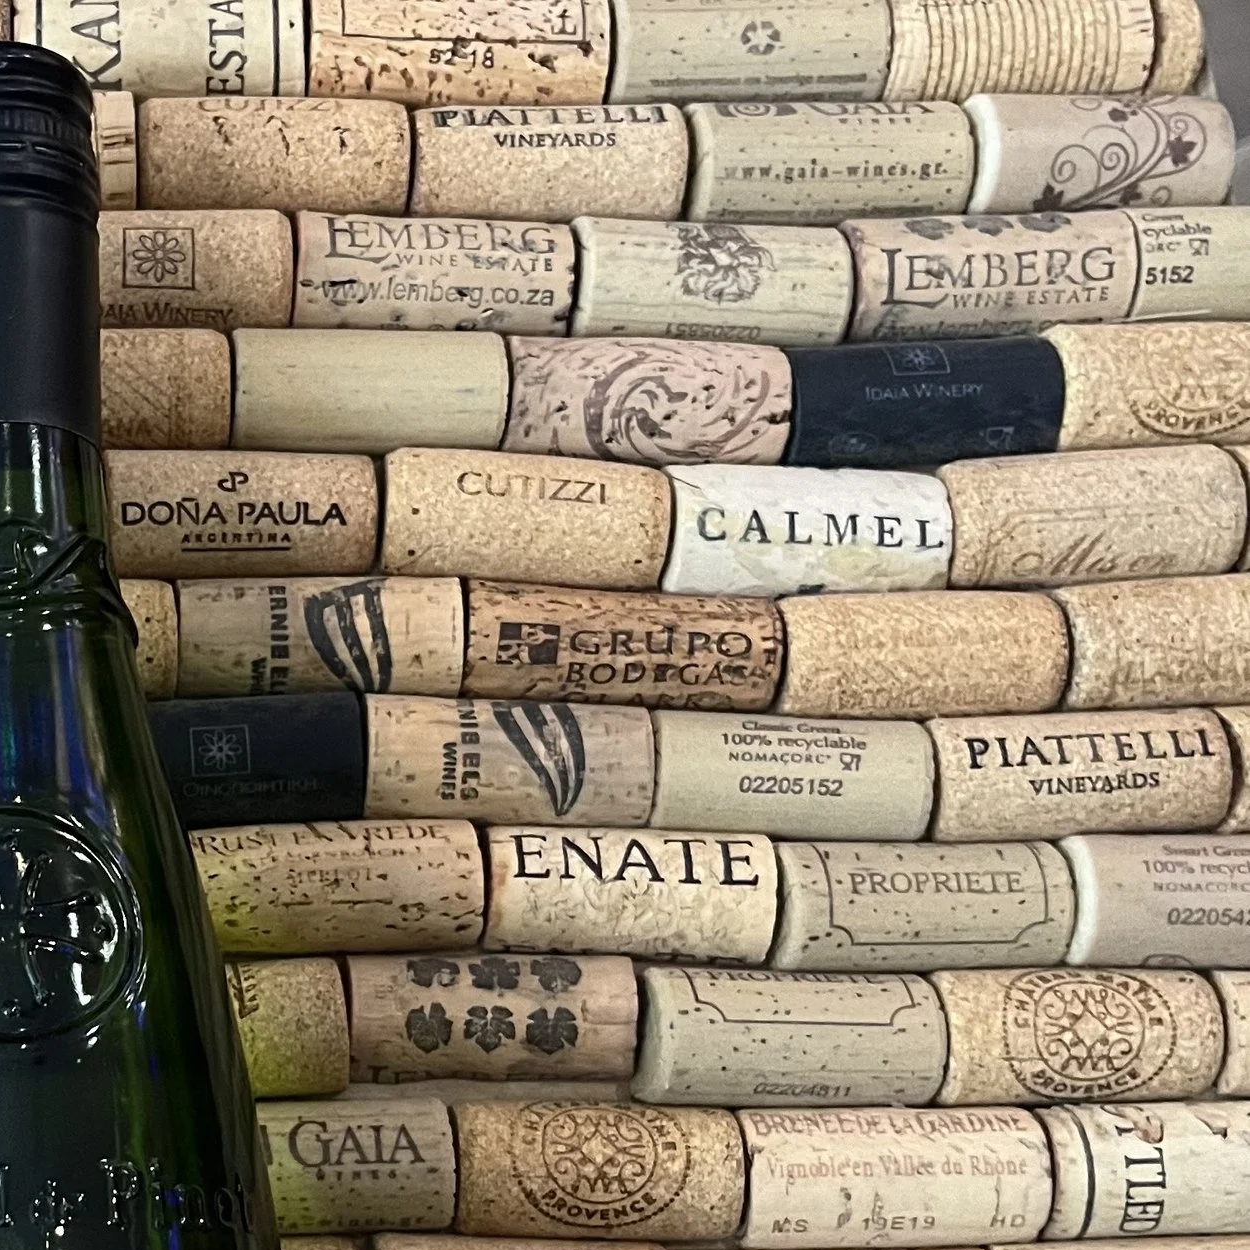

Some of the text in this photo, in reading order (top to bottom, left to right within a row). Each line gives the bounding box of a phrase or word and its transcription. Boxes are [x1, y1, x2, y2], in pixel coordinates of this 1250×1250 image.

[206, 0, 245, 97] ESTA
[433, 104, 668, 128] PIATTELLI
[495, 131, 617, 149] VINEYARDS
[324, 215, 556, 263] LEMBERG
[396, 252, 459, 267] WINE
[881, 246, 1116, 309] LEMBERG
[1145, 265, 1195, 285] 5152
[952, 286, 1110, 309] WINE ESTATE
[456, 470, 608, 504] CUTIZZI
[121, 497, 348, 527] DOÑA PAULA
[181, 531, 293, 545] ARGENTINA
[696, 506, 945, 549] CALMEL
[570, 629, 752, 656] GRUPO
[721, 733, 868, 752] 100% recyclable
[965, 728, 1217, 769] PIATTELLI
[739, 775, 844, 797] 02205152
[1028, 771, 1161, 796] VINEYARDS
[510, 834, 760, 886] ENATE
[1143, 859, 1196, 875] 100%
[850, 871, 1025, 895] PROPRIETE
[288, 1119, 425, 1168] GAIA
[767, 1156, 846, 1182] Vignoble
[541, 1189, 658, 1221] PROVENCE
